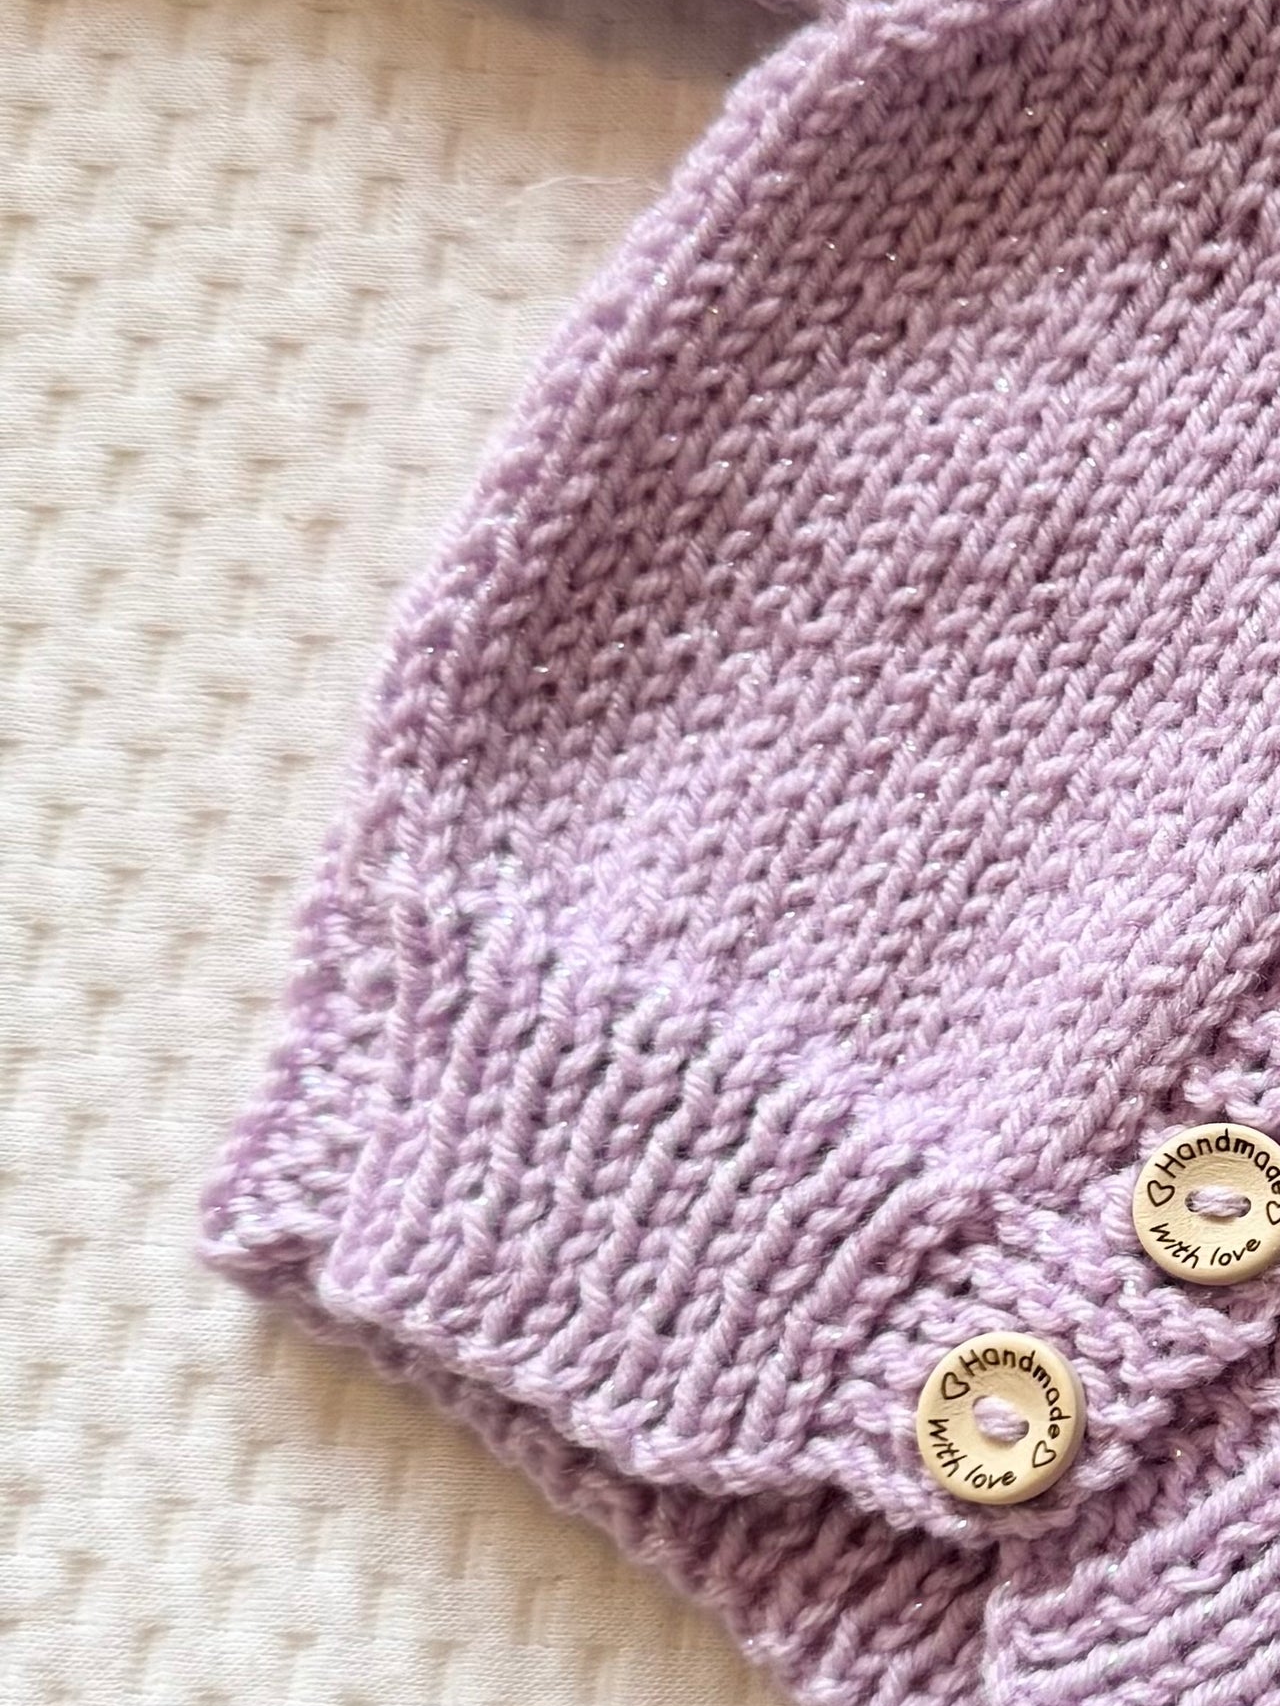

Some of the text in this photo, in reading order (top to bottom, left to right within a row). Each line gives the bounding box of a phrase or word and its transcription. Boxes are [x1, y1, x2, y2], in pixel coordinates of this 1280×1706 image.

[1210, 1238, 1261, 1266] love
[959, 1348, 1072, 1440] Handmade
[964, 1464, 1017, 1489] love
